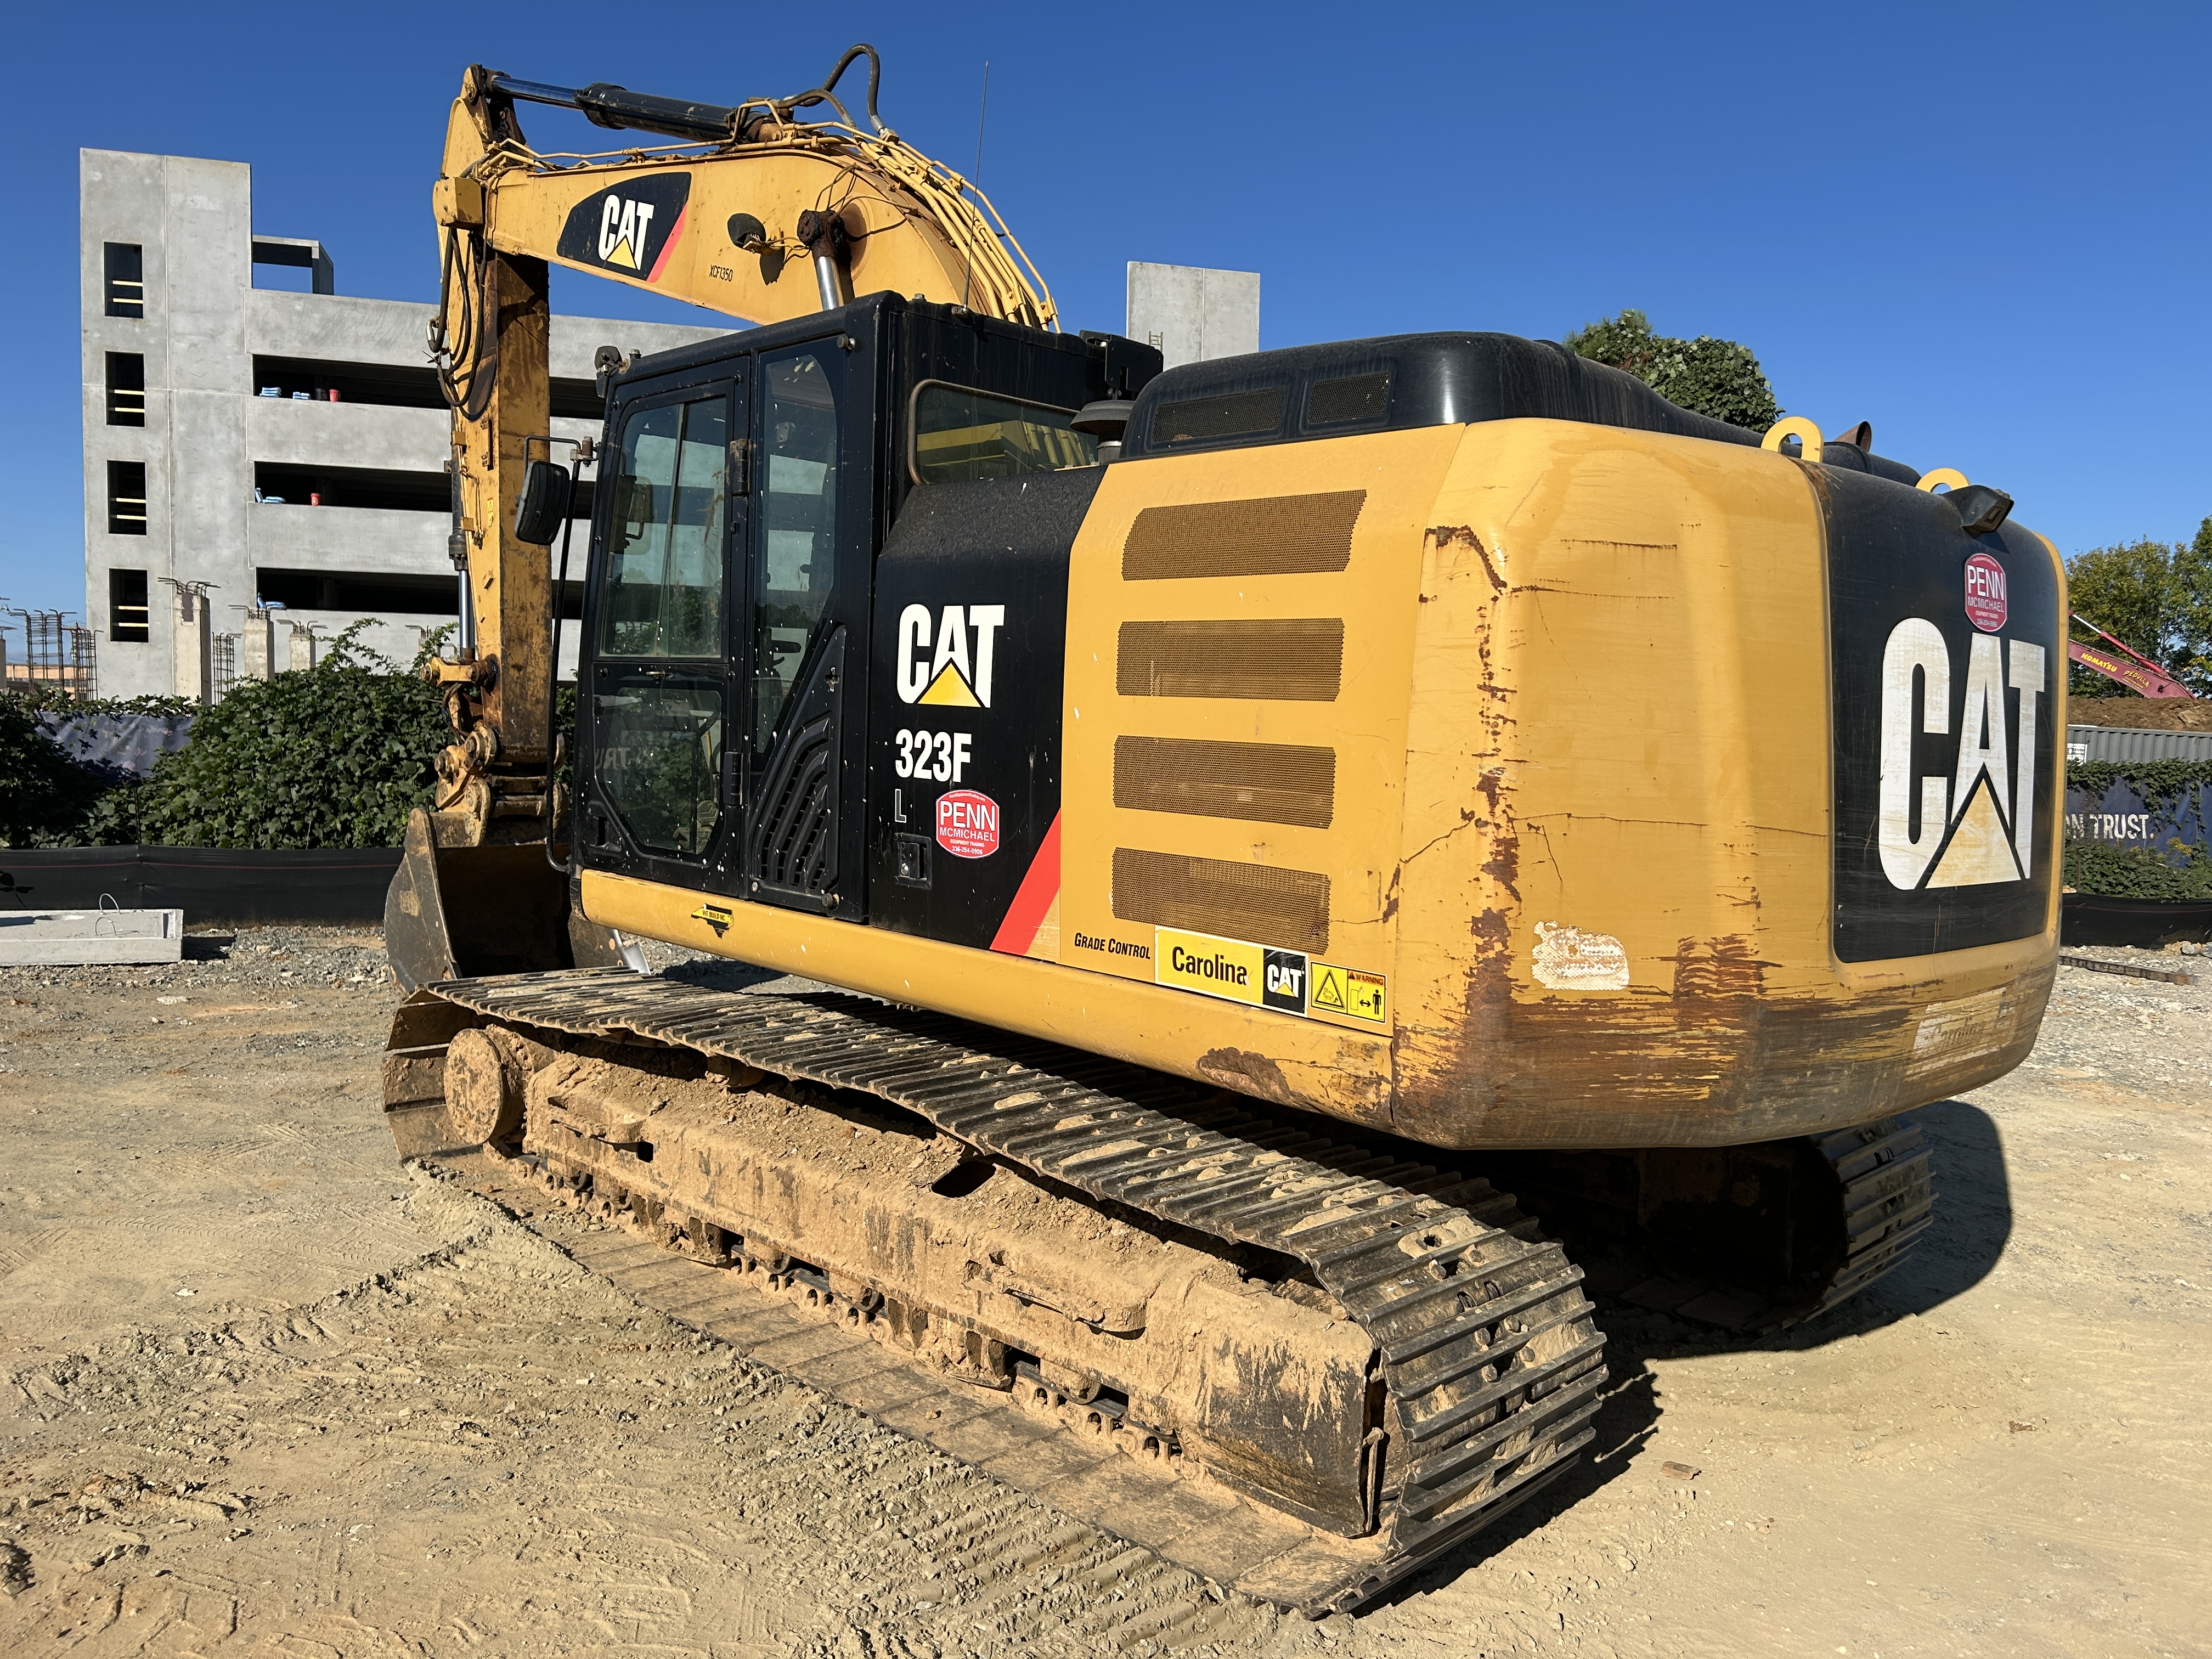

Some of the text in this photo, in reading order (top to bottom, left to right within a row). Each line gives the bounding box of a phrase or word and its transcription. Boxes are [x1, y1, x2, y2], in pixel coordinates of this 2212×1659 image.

[598, 194, 654, 270] CAT
[709, 264, 733, 282] XCF1350
[1967, 565, 2005, 601] PENN
[1968, 596, 2005, 613] MCMICHAEL
[896, 603, 1005, 708] CAT
[2080, 653, 2118, 673] KOMATSU
[2123, 670, 2150, 688] PEDULLA
[895, 729, 972, 783] 323F
[1878, 617, 2045, 890] CAT
[895, 788, 907, 823] L
[940, 800, 996, 832] PENN
[939, 826, 996, 842] MCMICHAEL
[709, 911, 719, 919] BUILD
[1074, 932, 1150, 960] GRADE CONTROL
[1171, 946, 1302, 998] Carolina CAT
[1355, 973, 1384, 985] WARNING
